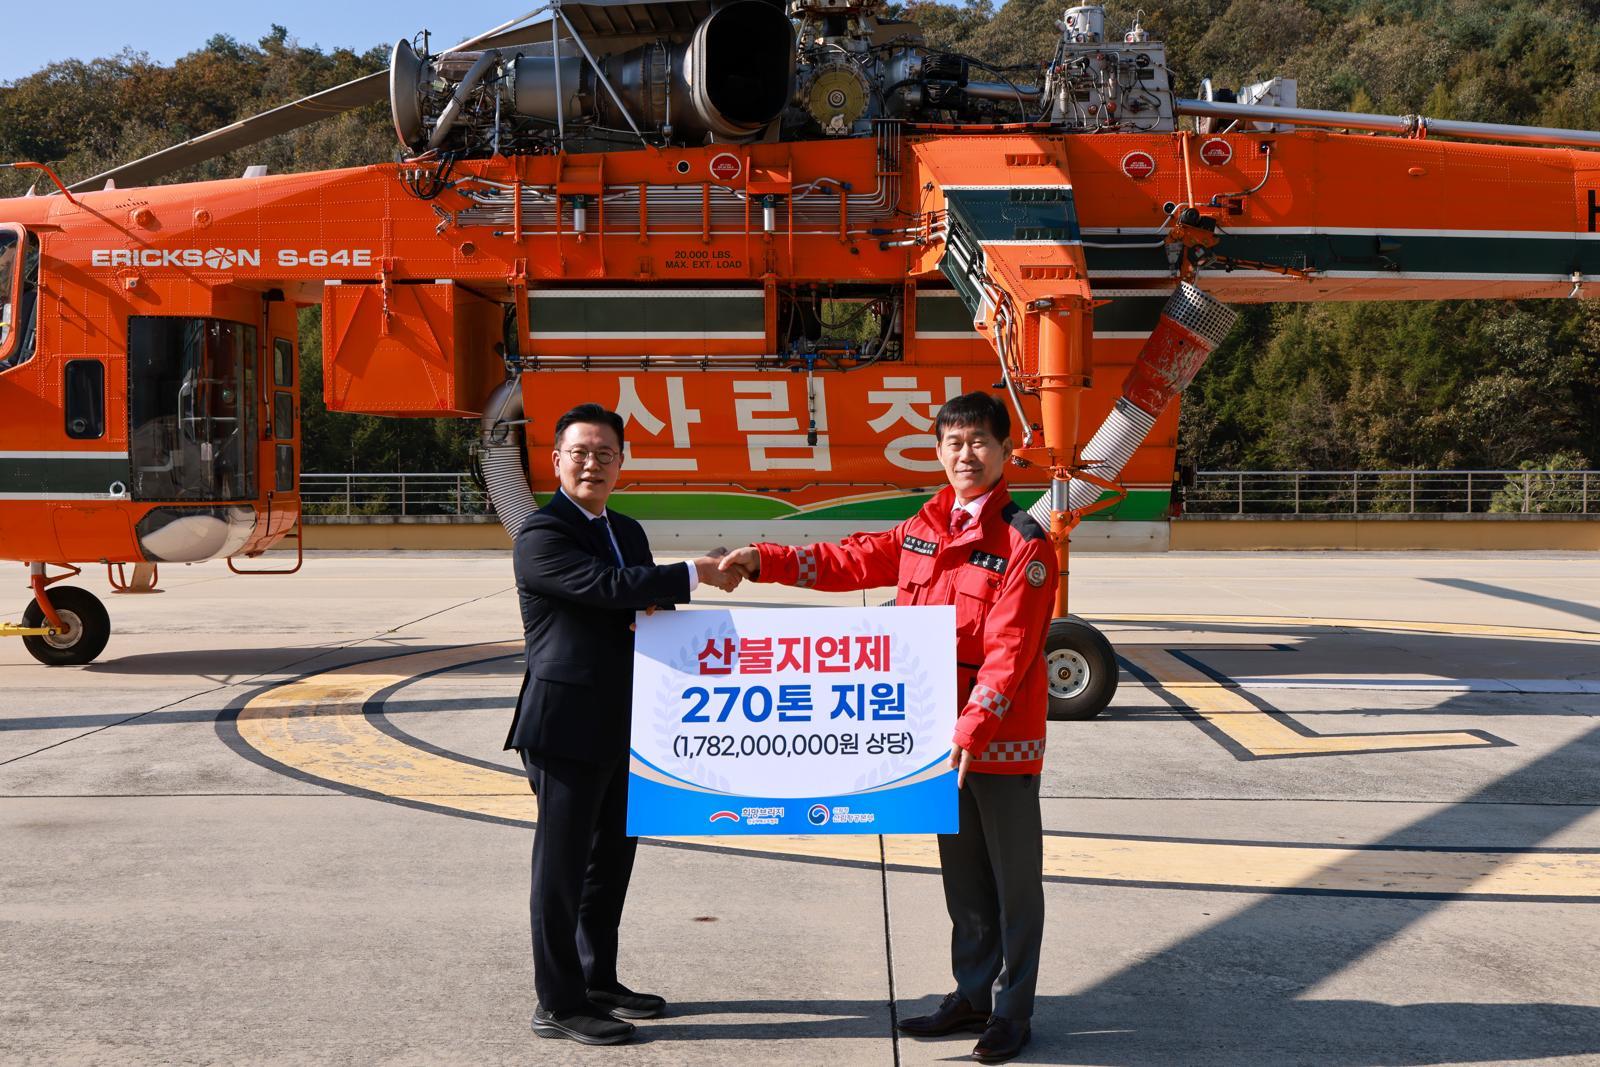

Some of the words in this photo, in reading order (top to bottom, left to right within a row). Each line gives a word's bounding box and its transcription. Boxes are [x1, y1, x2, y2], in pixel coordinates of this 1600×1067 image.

[91, 247, 260, 270] ERICKSON
[278, 249, 371, 267] S-64E
[665, 260, 688, 268] MAX.
[692, 260, 713, 268] EXT.
[716, 260, 742, 268] LOAD
[615, 376, 962, 472] 산림청
[697, 635, 891, 675] 산불지연제
[681, 684, 814, 723] 270톤
[830, 683, 906, 721] 지원
[672, 733, 859, 759] (1,782,000,000원
[865, 731, 915, 756] 상당)
